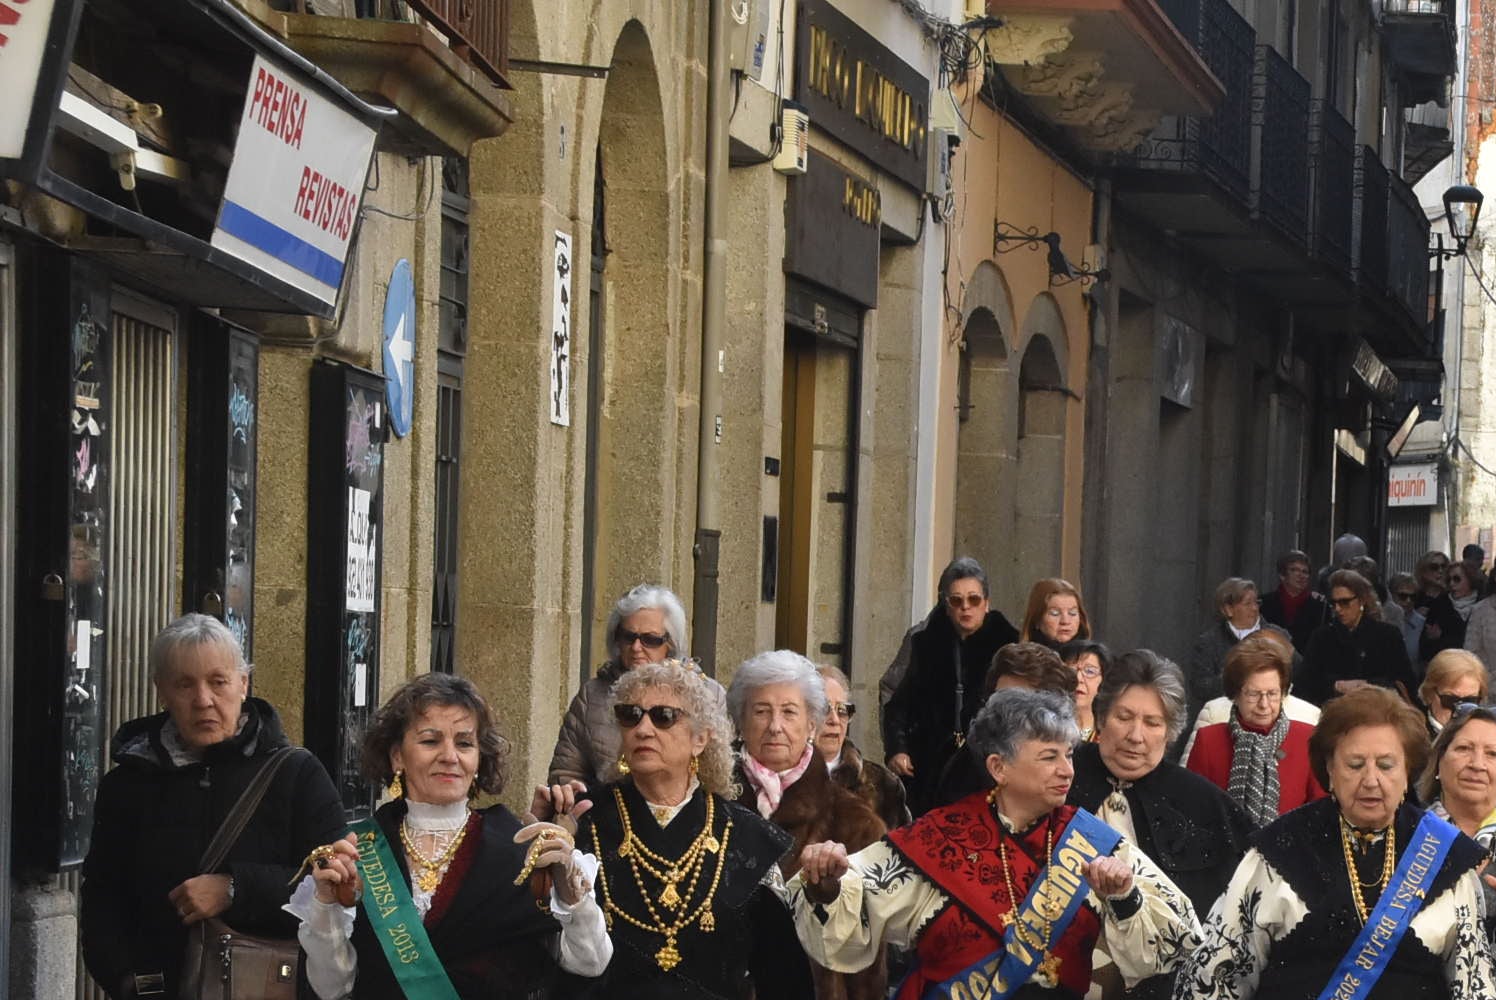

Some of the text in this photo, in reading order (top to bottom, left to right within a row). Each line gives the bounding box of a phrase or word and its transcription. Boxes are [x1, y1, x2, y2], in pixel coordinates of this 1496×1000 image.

[250, 67, 309, 150] PRENSA
[294, 166, 357, 242] REVISTAS
[1389, 472, 1426, 503] iquinín
[1005, 829, 1098, 966] AGUEDESA
[1391, 832, 1441, 911] AGUEDESA
[1355, 915, 1399, 971] BEJAR
